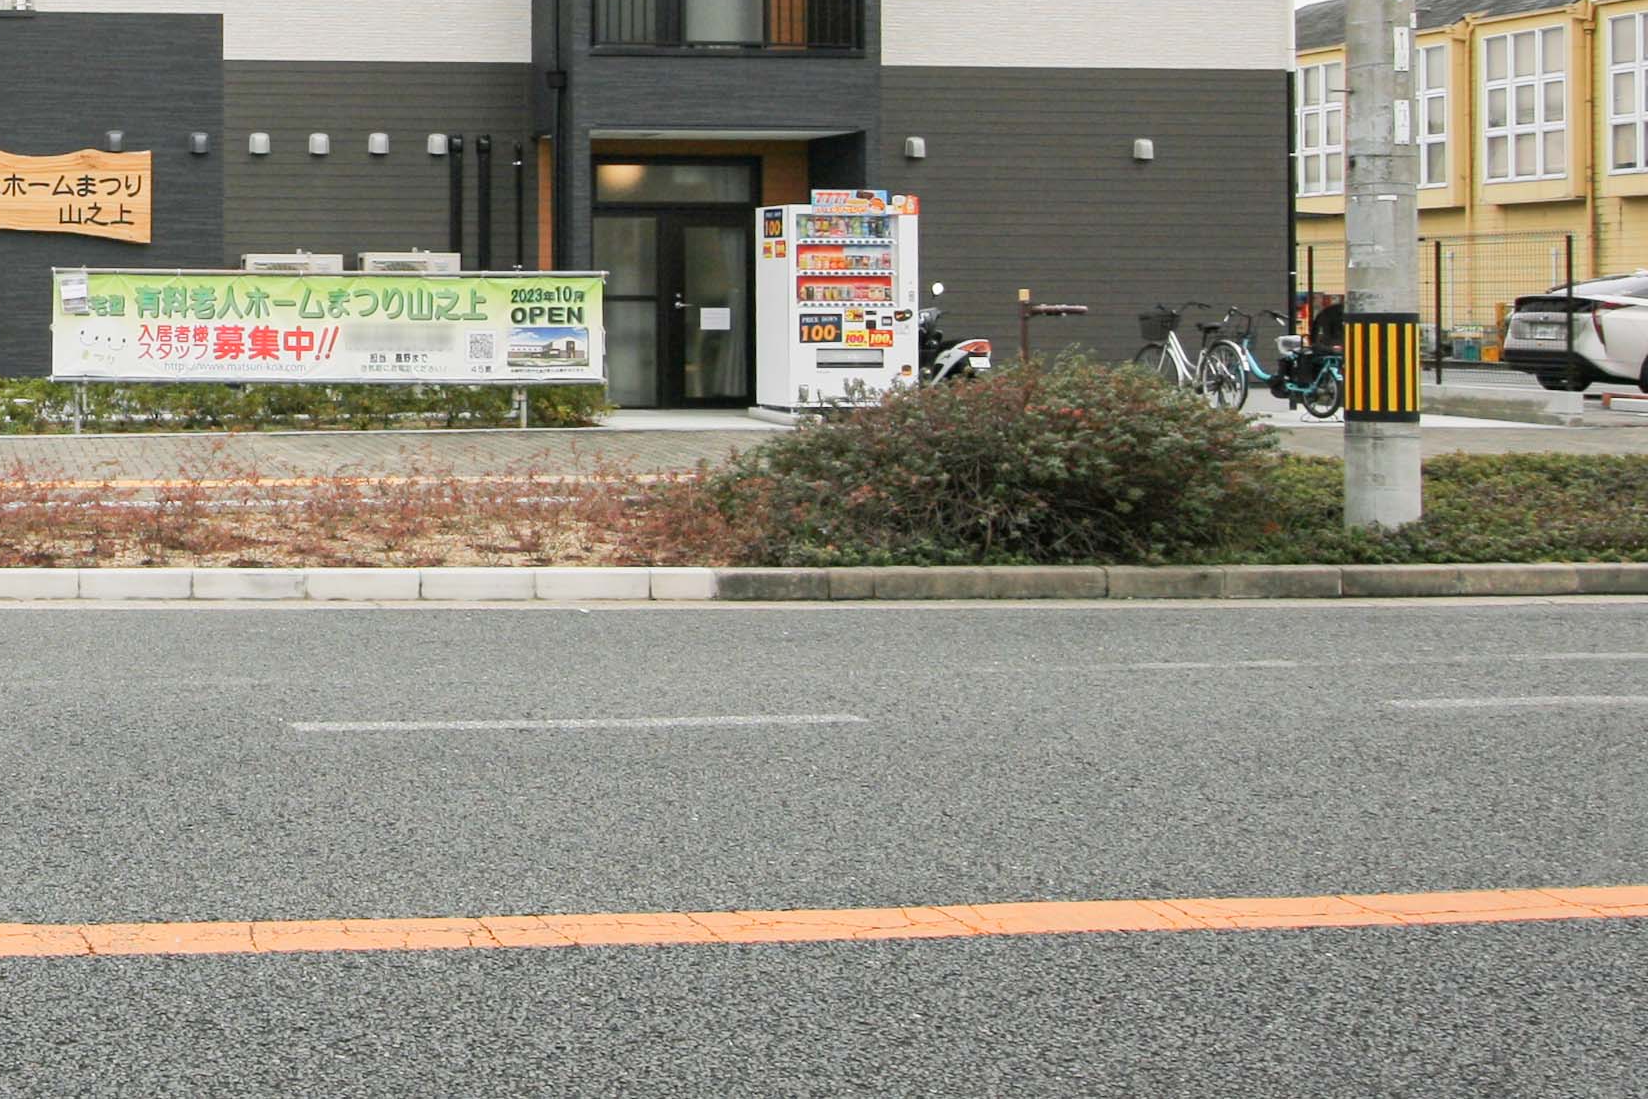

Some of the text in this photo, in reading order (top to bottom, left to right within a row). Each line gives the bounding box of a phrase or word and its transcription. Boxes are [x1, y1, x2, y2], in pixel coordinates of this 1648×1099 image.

[59, 202, 135, 226] 山之上
[74, 293, 126, 317] 宅型
[135, 284, 489, 321] 有料老人ホームまつり山之上
[510, 286, 585, 304] 2023年10月
[510, 306, 584, 324] OPEN
[138, 324, 210, 342] 入居者様
[801, 324, 836, 342] 100
[138, 343, 209, 360] スタッフ
